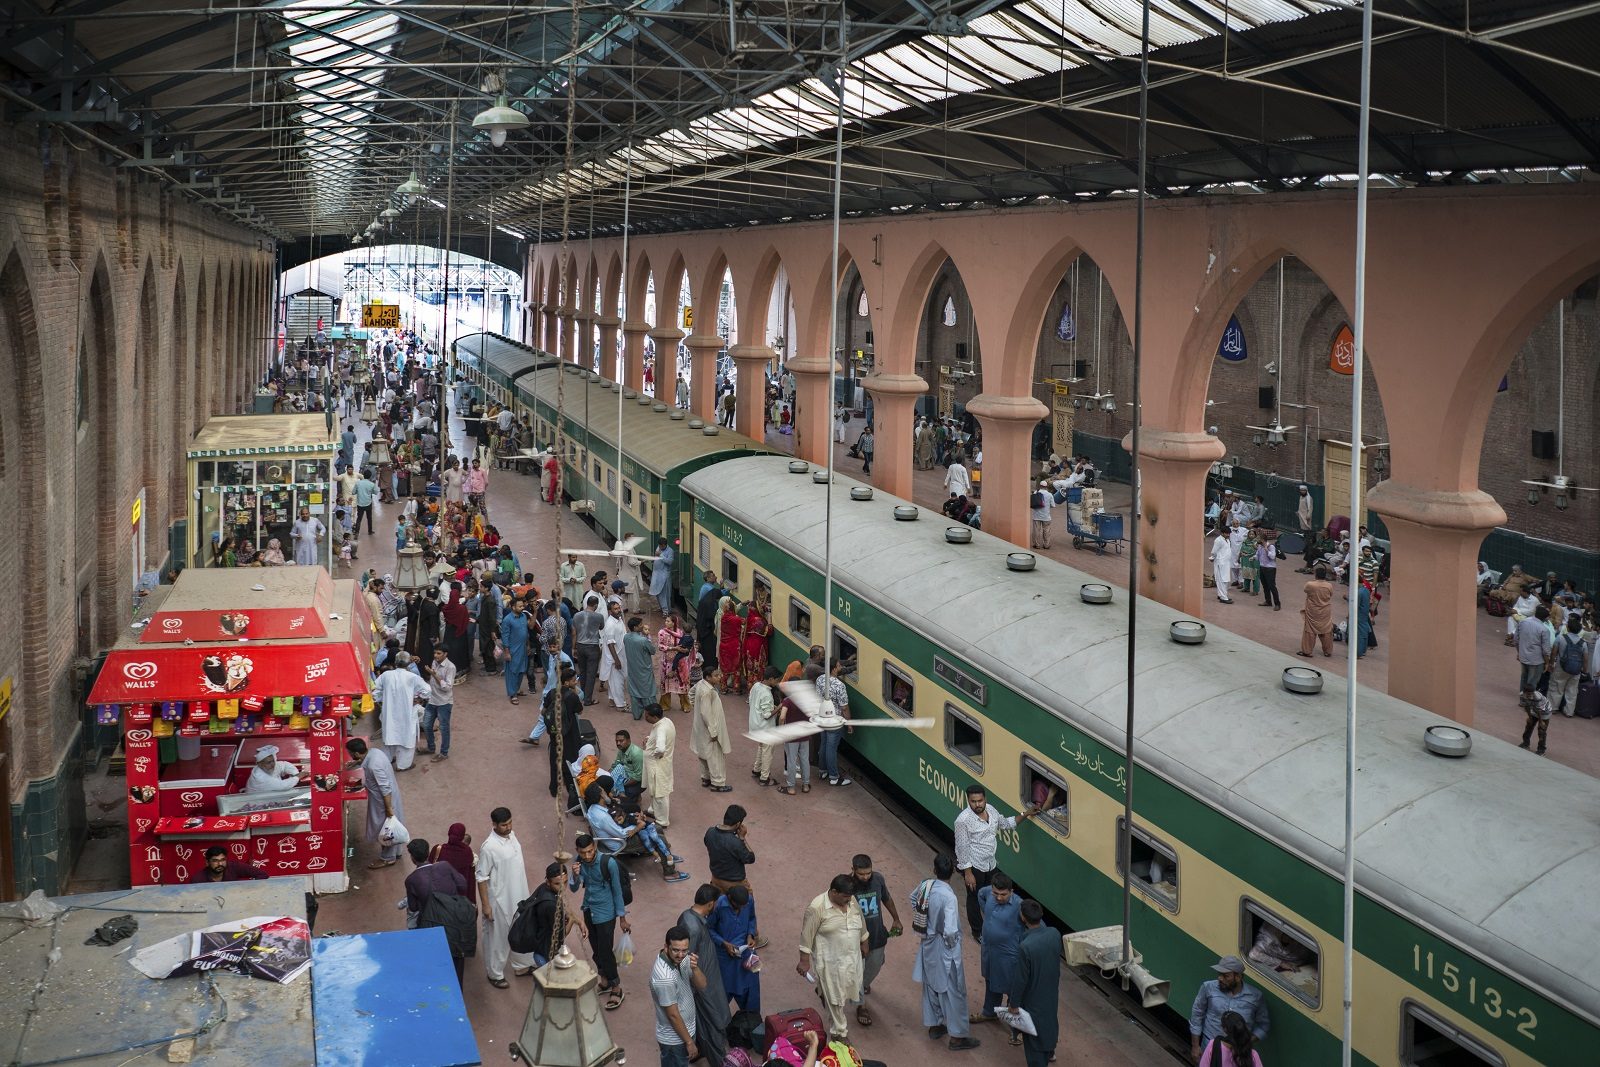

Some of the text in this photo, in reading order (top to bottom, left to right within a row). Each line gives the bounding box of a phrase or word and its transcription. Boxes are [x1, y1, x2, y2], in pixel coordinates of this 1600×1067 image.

[365, 307, 372, 317] 4
[364, 318, 396, 327] LAHORE
[722, 523, 743, 547] 11513-2
[306, 661, 328, 671] TASTE
[307, 668, 328, 679] JOY
[125, 680, 155, 689] WALL'S
[996, 828, 1020, 853] ASS
[858, 896, 878, 916] 94
[1413, 943, 1538, 1041] 11513-2
